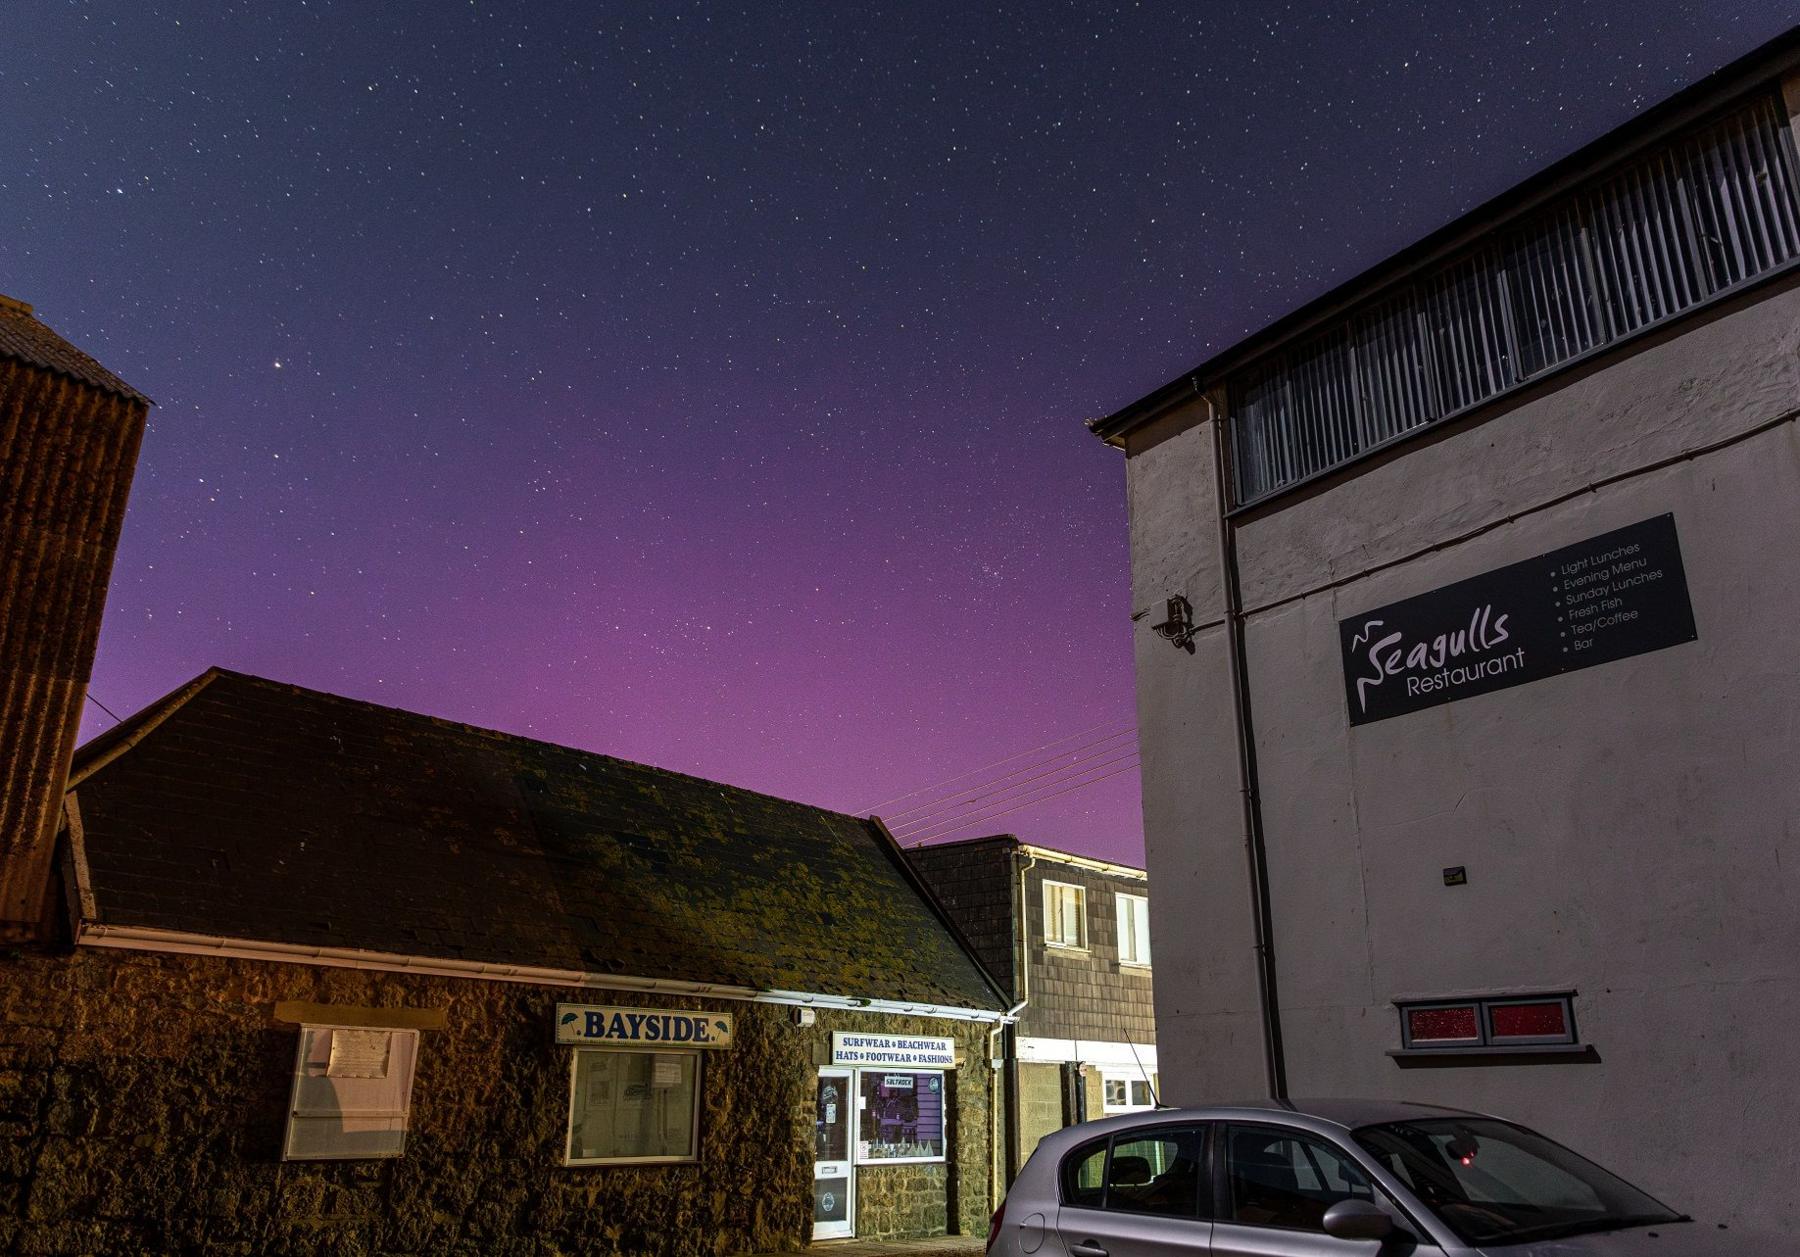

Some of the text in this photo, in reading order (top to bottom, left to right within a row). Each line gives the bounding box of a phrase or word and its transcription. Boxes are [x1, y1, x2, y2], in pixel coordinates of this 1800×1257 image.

[1561, 544, 1640, 575] Light Lunches
[1564, 558, 1647, 590] Evening Menu
[1566, 569, 1663, 605] Sunday Lunches
[1569, 597, 1623, 620] Fresh Fish
[1570, 610, 1638, 635] Tea/Coffee
[1356, 604, 1509, 714] Seagulls
[1574, 639, 1593, 651] Bar
[1406, 647, 1525, 697] Restaurant
[584, 1011, 710, 1042] BAYSIDE
[835, 1051, 953, 1063] HATS FOOTWEAR FASHIONS
[843, 1037, 947, 1051] SURFWEAR BEACHWEAR
